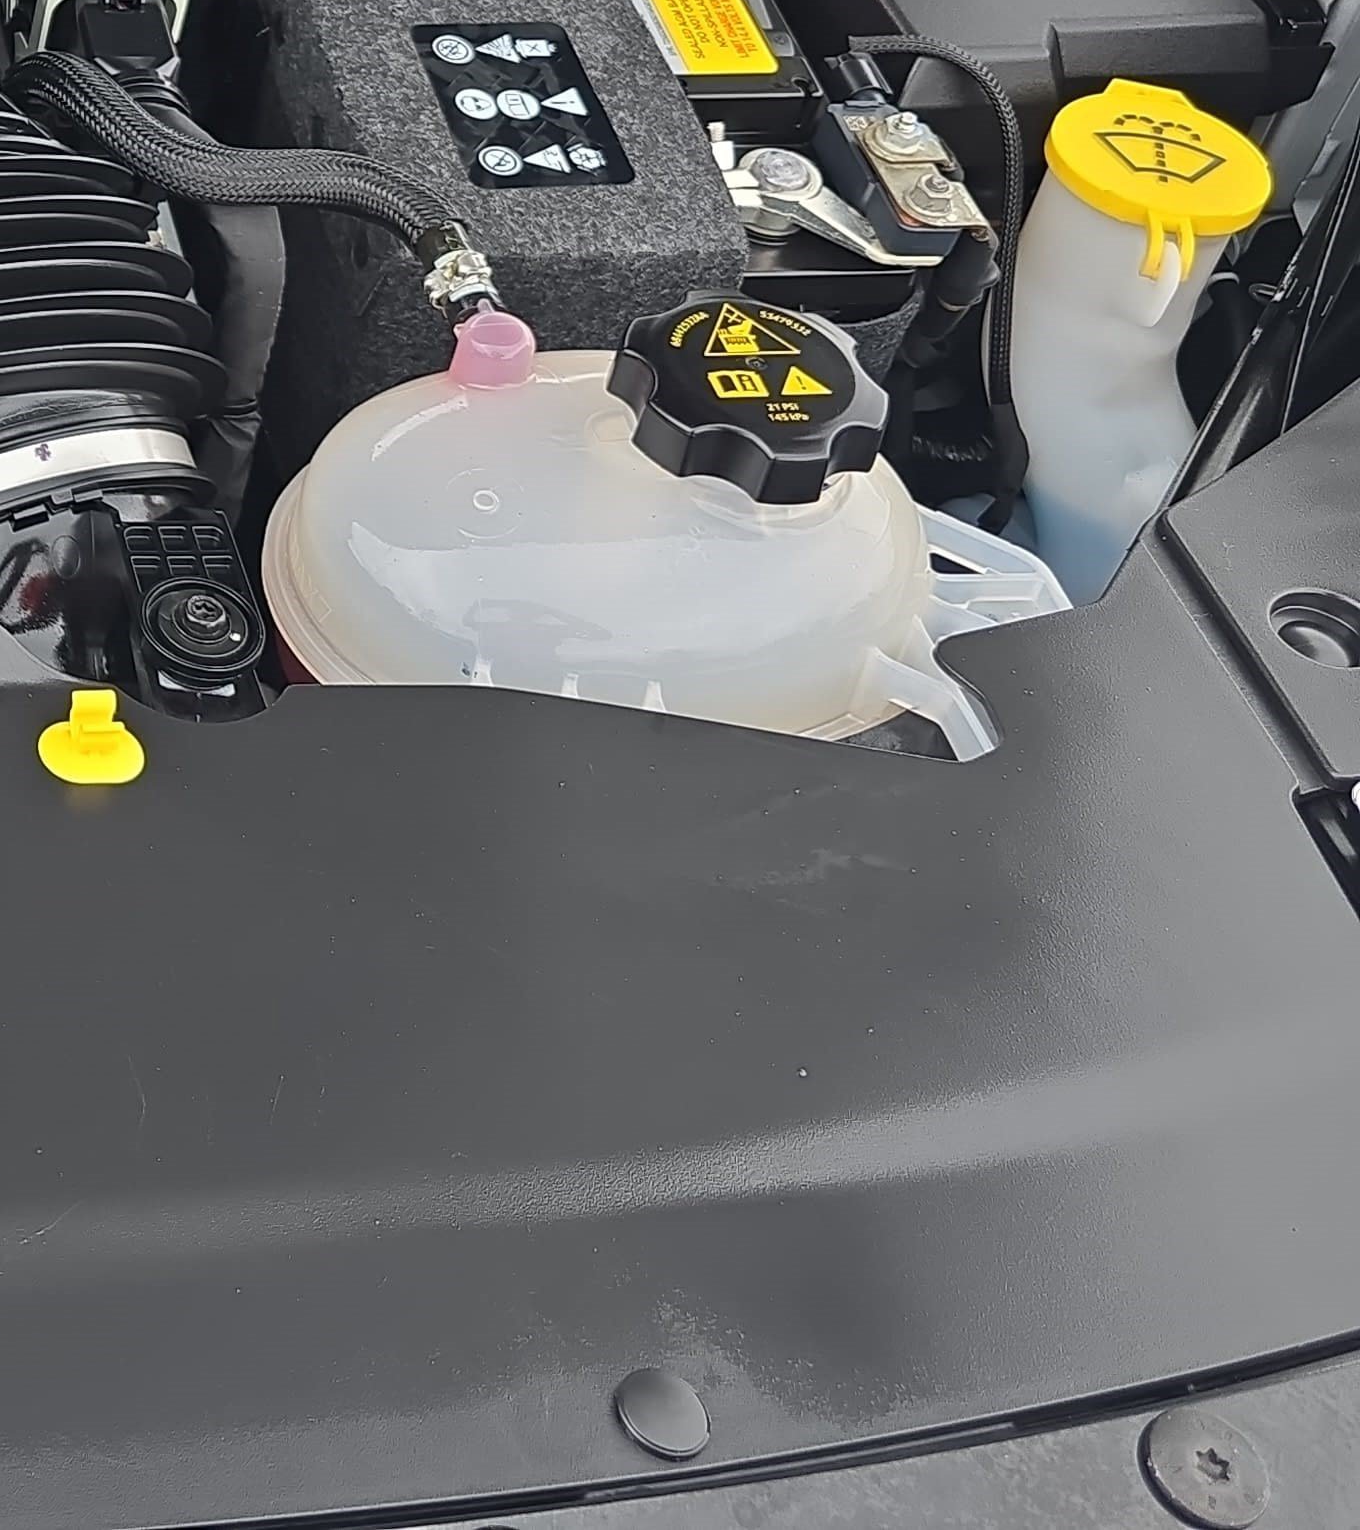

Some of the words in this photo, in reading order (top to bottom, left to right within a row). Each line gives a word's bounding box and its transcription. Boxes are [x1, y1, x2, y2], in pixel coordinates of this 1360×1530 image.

[672, 8, 688, 26] AGM
[687, 15, 702, 29] NOT
[681, 28, 705, 58] SEALED
[696, 31, 710, 42] DO
